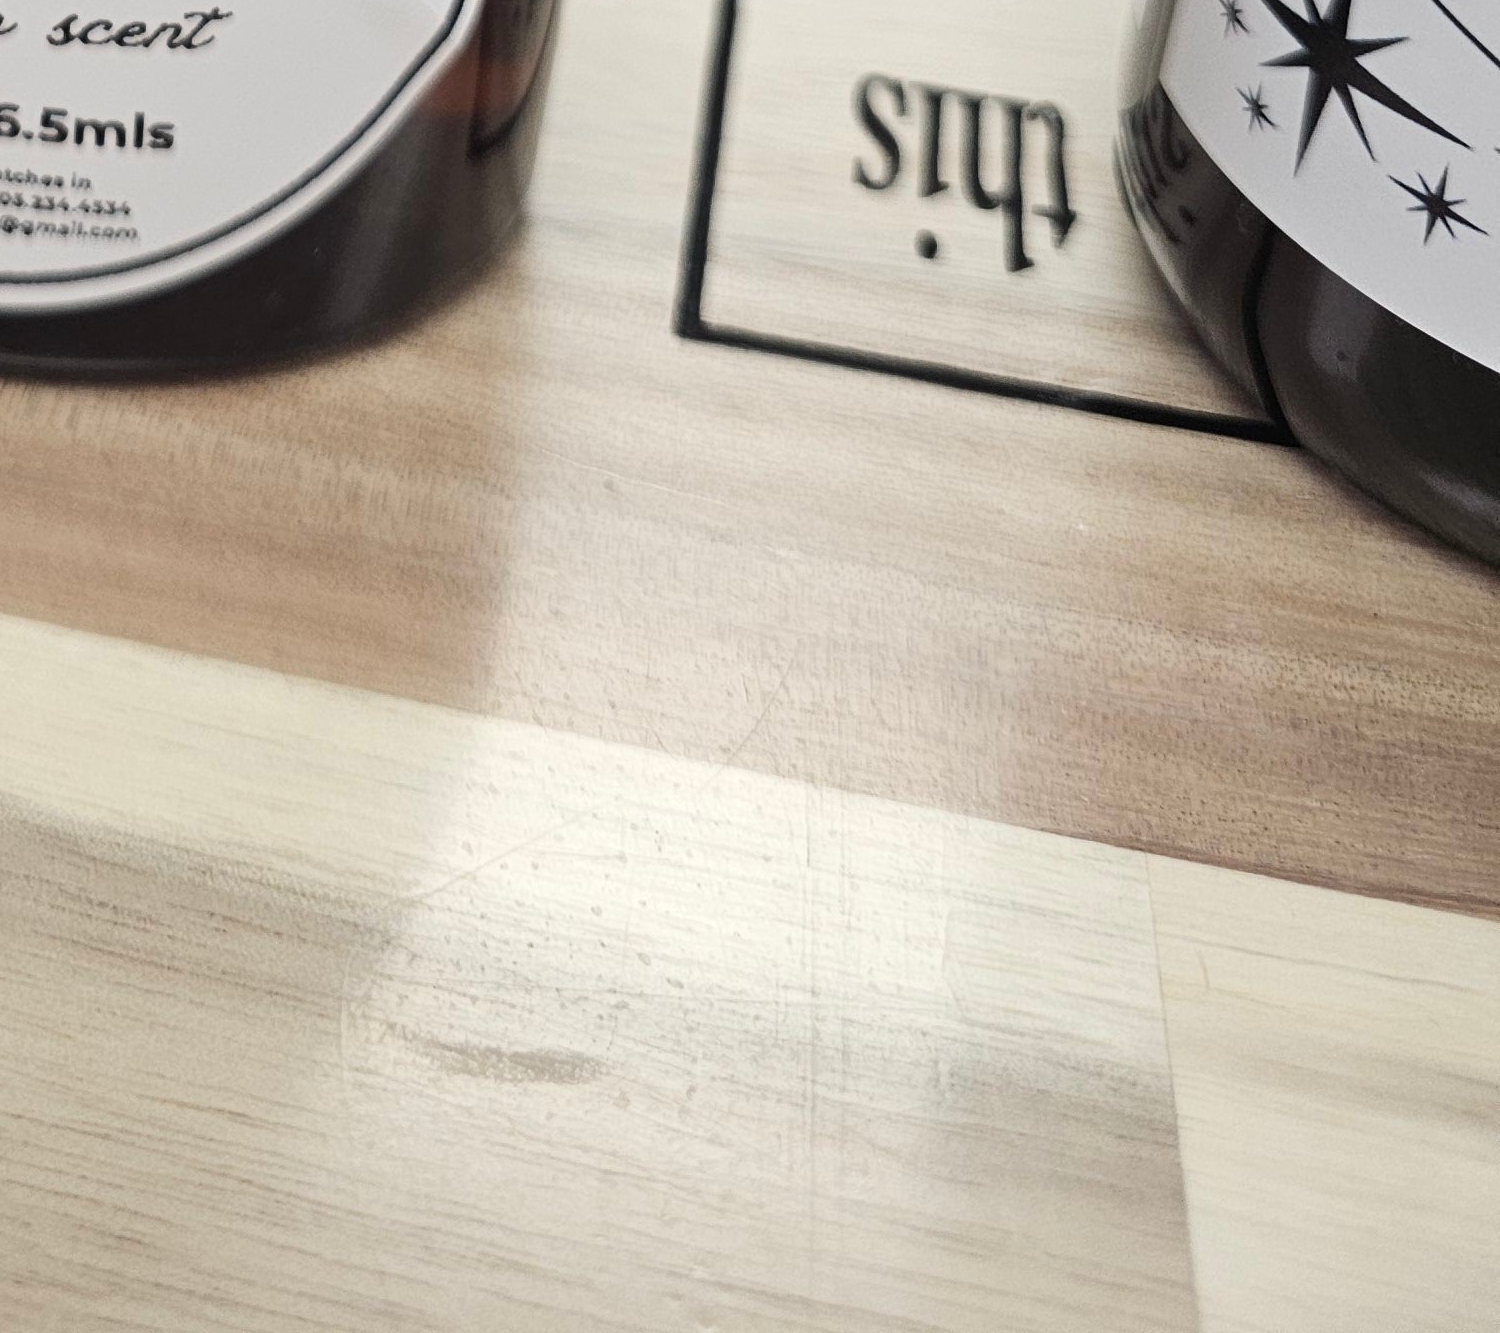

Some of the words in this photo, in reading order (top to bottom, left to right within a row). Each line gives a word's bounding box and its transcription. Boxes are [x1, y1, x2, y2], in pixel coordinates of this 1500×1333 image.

[45, 6, 233, 50] scent
[71, 170, 92, 191] in
[852, 71, 1078, 273] this
